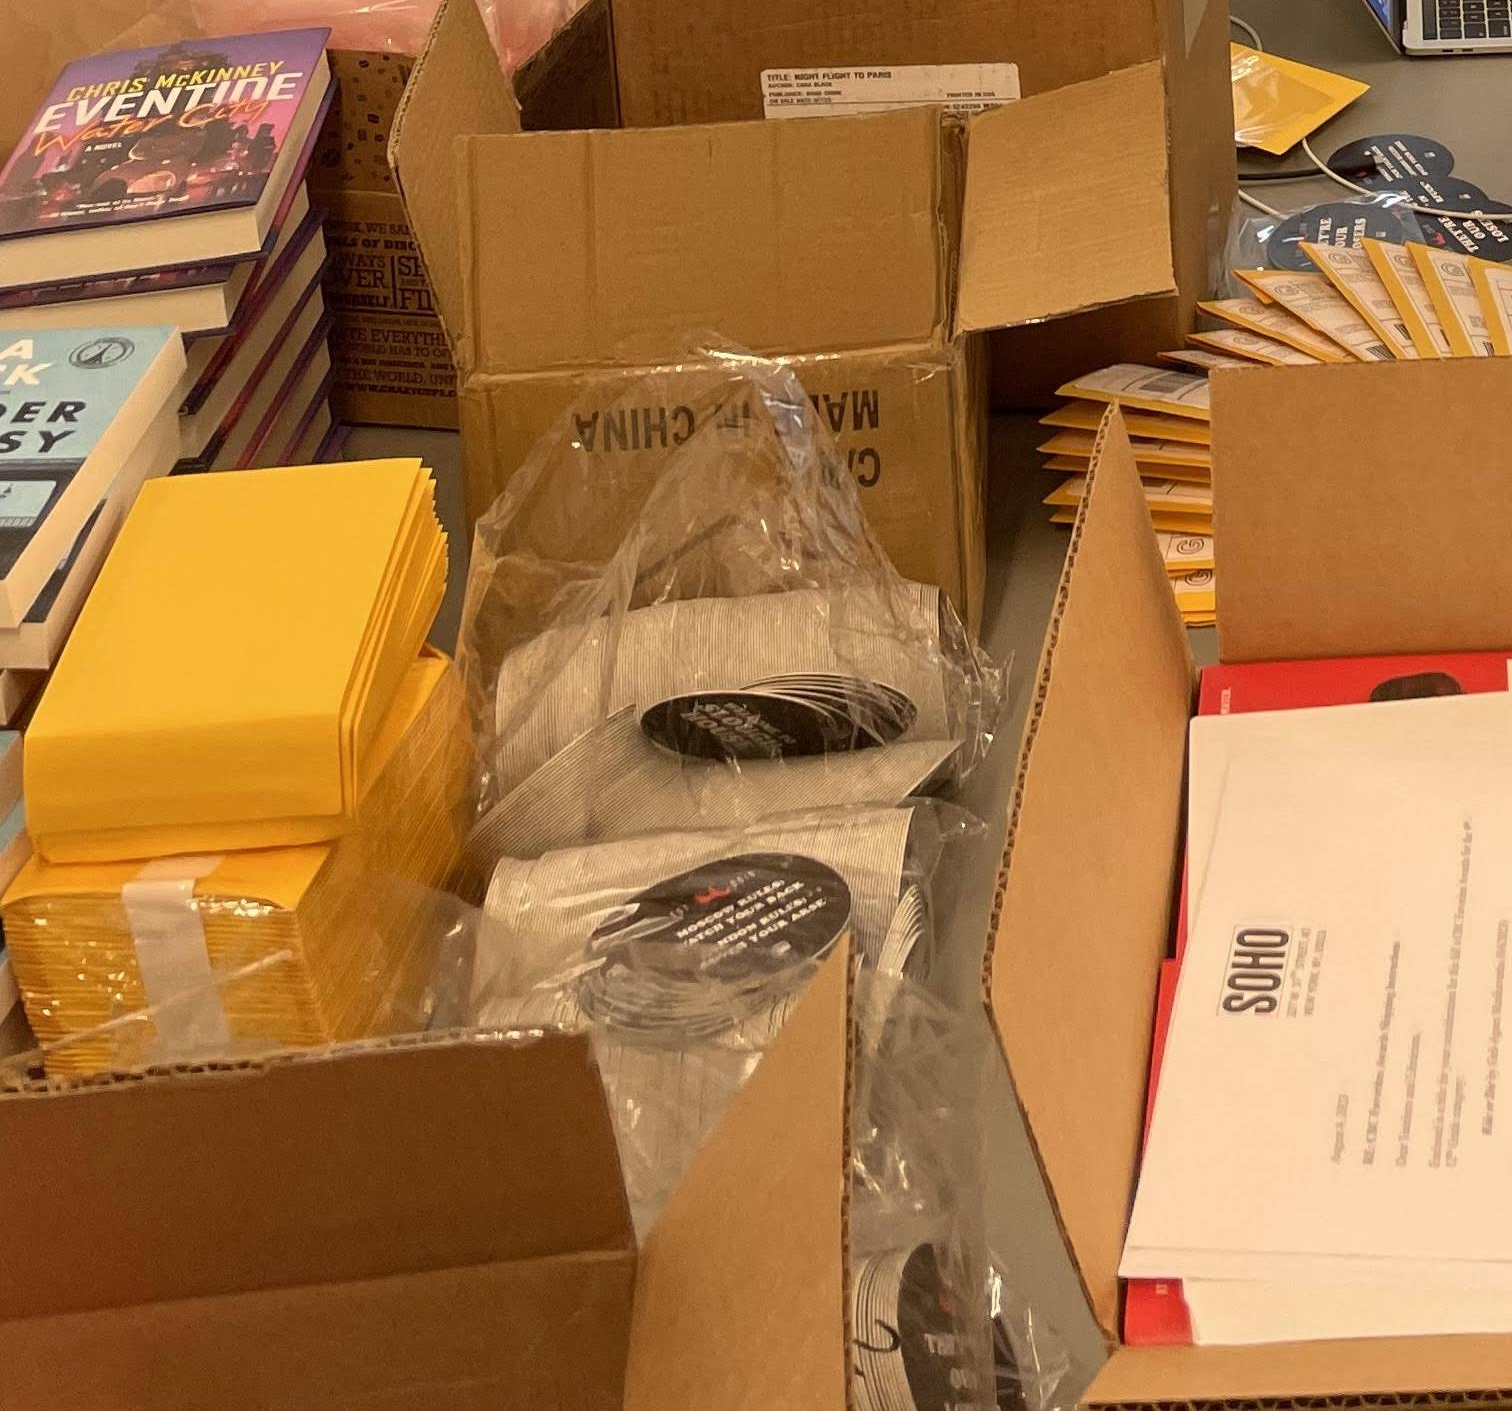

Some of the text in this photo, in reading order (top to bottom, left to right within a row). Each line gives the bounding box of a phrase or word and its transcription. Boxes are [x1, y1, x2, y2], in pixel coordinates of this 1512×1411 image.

[794, 72, 819, 81] NIGHT
[822, 71, 851, 80] FLIGHT
[854, 71, 865, 79] TO
[866, 71, 892, 79] PARIS
[66, 77, 148, 103] CHRIS
[33, 72, 304, 135] EVENTIDE
[35, 99, 271, 157] Water City
[94, 142, 122, 151] NOVEL
[1437, 216, 1479, 252] THEY'RE
[1462, 220, 1486, 240] OUR
[1470, 209, 1509, 243] LOSES
[384, 241, 417, 252] DISC
[0, 338, 34, 360] A
[0, 362, 52, 386] K
[0, 400, 87, 424] ER
[808, 390, 880, 433] MA
[576, 405, 696, 453] CHINA
[676, 904, 735, 939] MOSCOW
[726, 901, 765, 926] YOUR
[717, 922, 757, 947] NDON
[749, 919, 789, 943] YOUR
[1222, 928, 1290, 1014] SOHO
